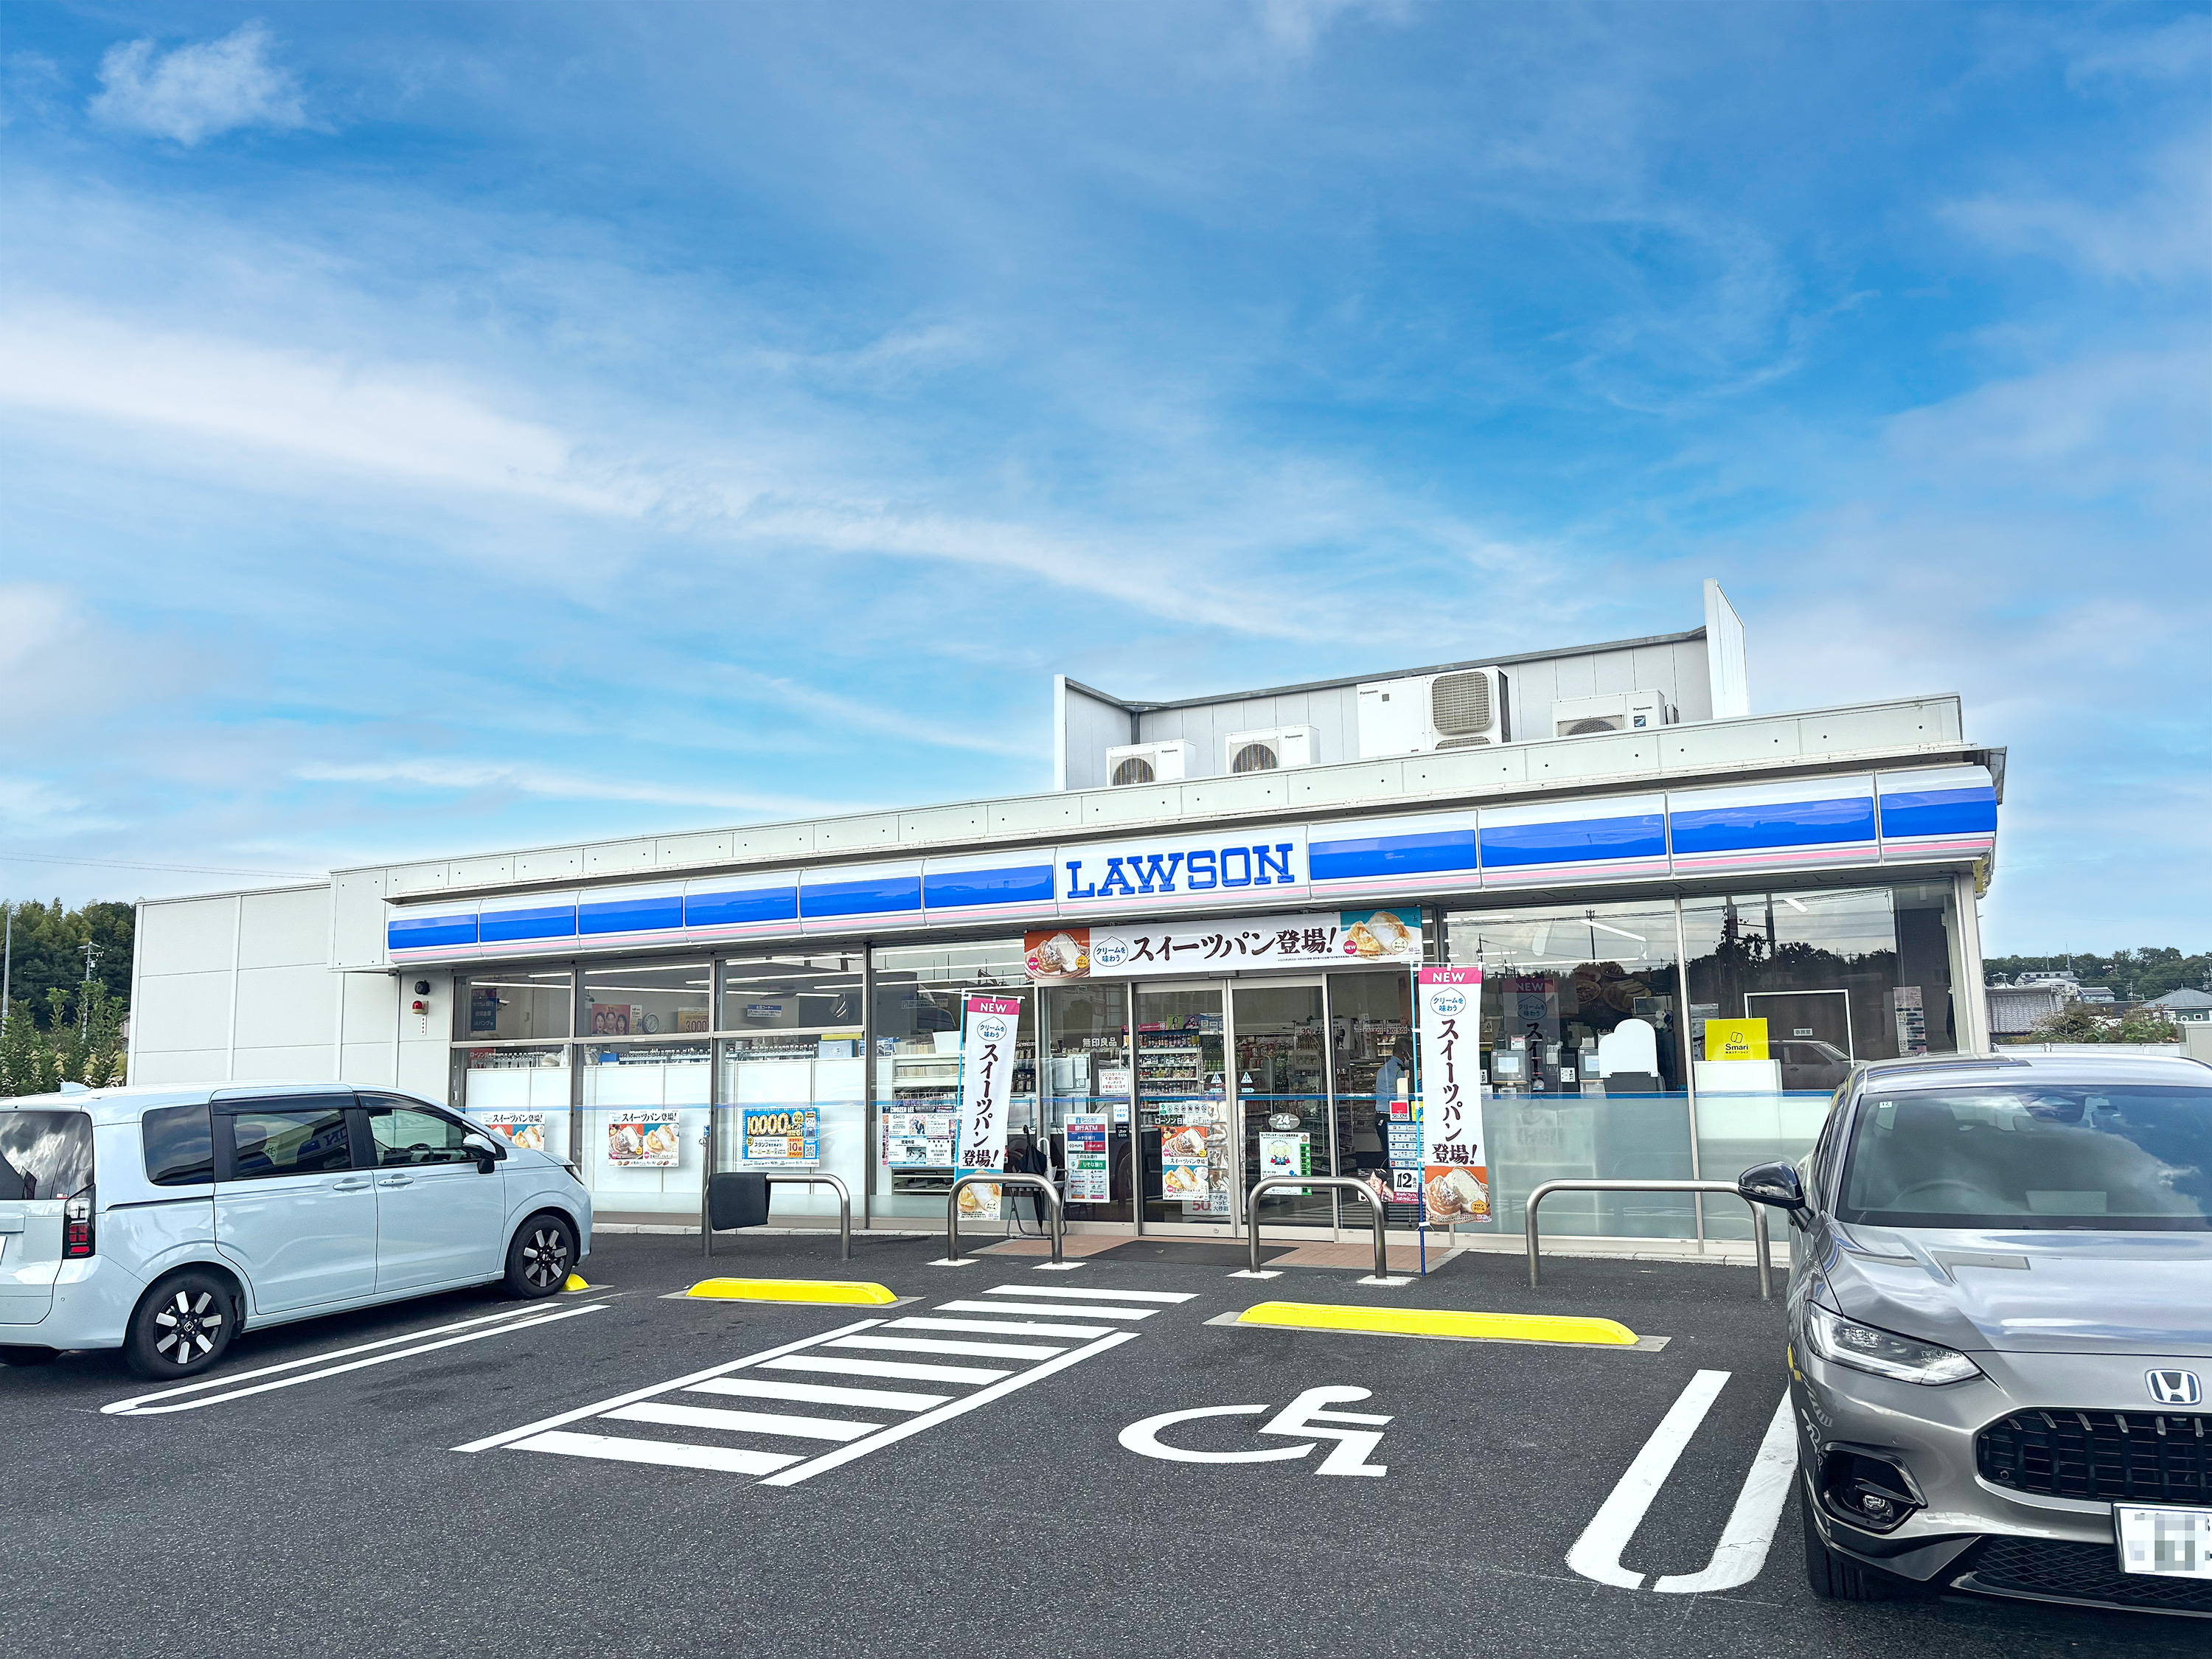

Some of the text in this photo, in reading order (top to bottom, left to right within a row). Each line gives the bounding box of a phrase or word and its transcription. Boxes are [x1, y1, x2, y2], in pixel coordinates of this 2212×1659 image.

[1066, 843, 1295, 899] LAWSON
[1128, 927, 1337, 961] スイーツパン登場!
[1102, 954, 1121, 962] 味わう
[1433, 972, 1465, 983] NEW
[1516, 982, 1543, 992] NEW
[980, 1002, 1007, 1013] NEW
[1082, 1037, 1117, 1047] 無印良品
[1437, 1018, 1462, 1142] スイーツパン
[973, 1043, 998, 1148] スイーツパン
[746, 1112, 790, 1136] 10,000
[1276, 1114, 1290, 1124] 24
[962, 1150, 999, 1168] 登場!
[1432, 1144, 1478, 1165] 登場!
[1397, 1172, 1412, 1188] 12
